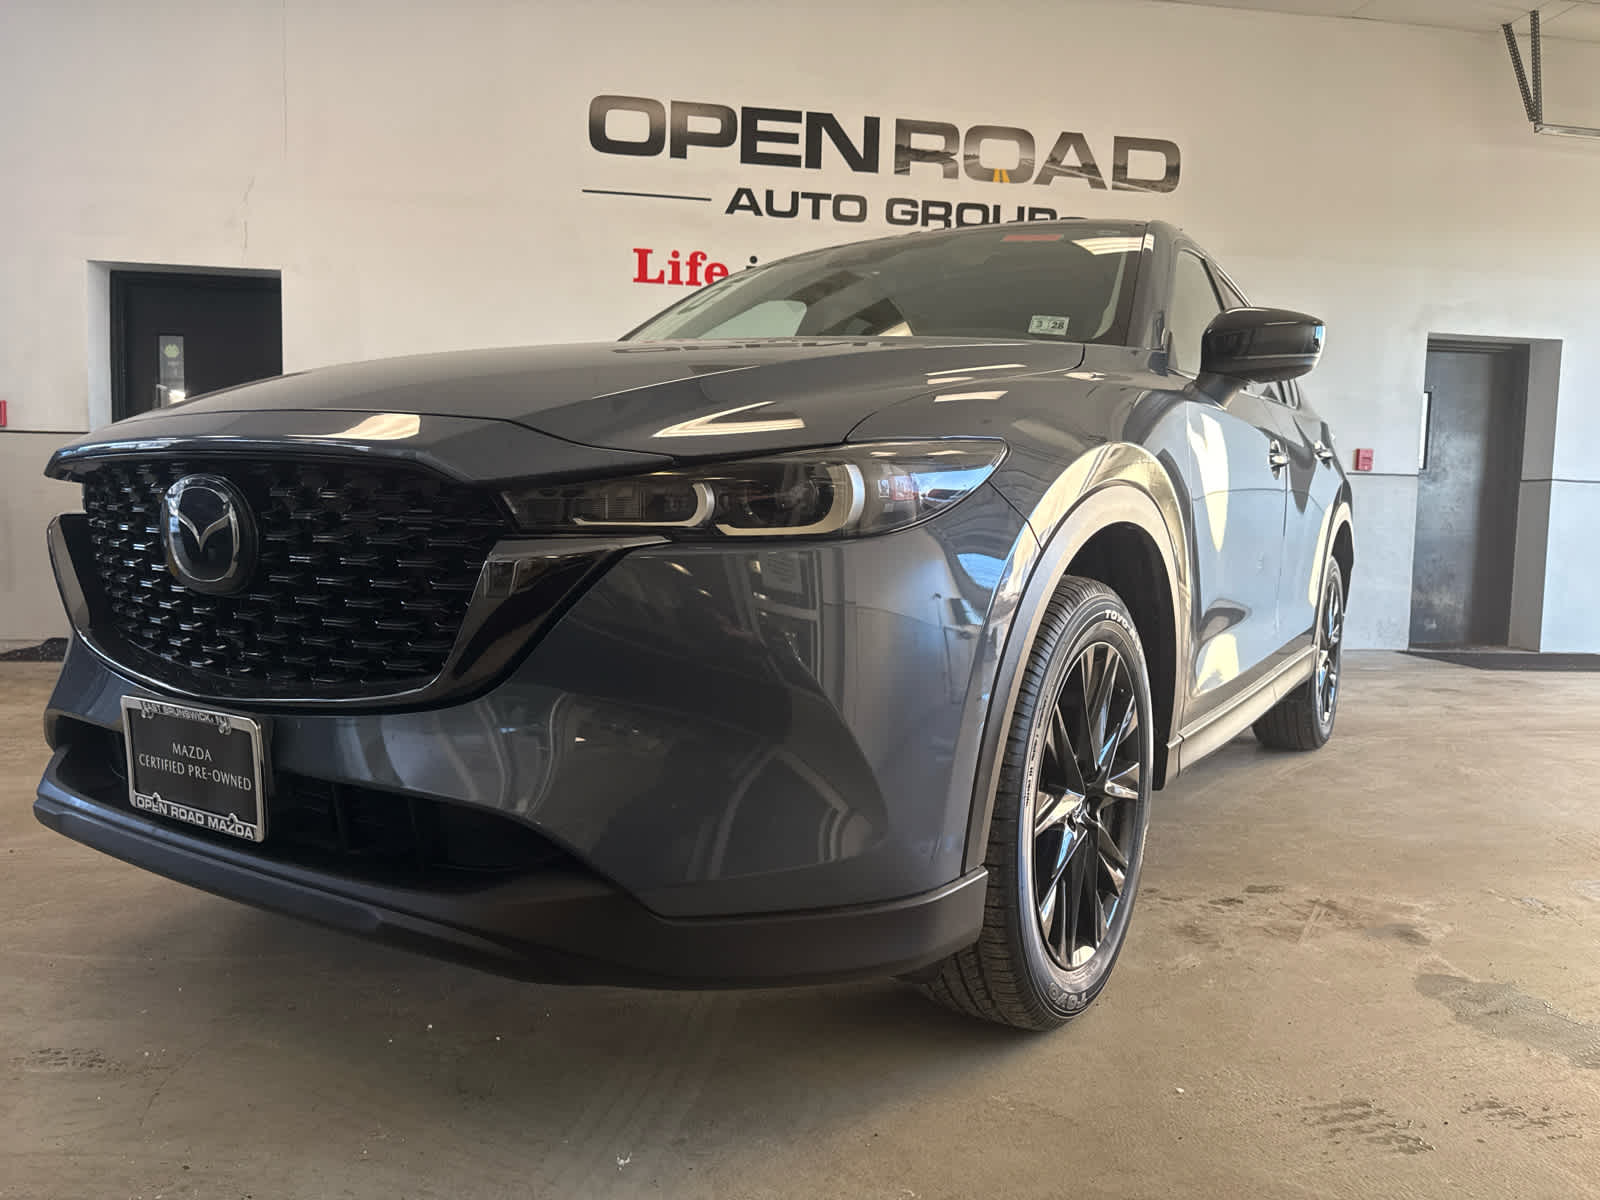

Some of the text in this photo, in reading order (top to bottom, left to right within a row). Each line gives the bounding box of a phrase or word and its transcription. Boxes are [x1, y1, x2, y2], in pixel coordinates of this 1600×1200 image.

[588, 94, 1182, 194] OPEN ROAD
[725, 188, 868, 223] AUTO
[632, 248, 729, 287] Life
[172, 742, 213, 761] MAZDA
[138, 753, 252, 791] CERTIFIED PRE-OWNED
[136, 796, 255, 840] OPEN ROAD MAZDA
